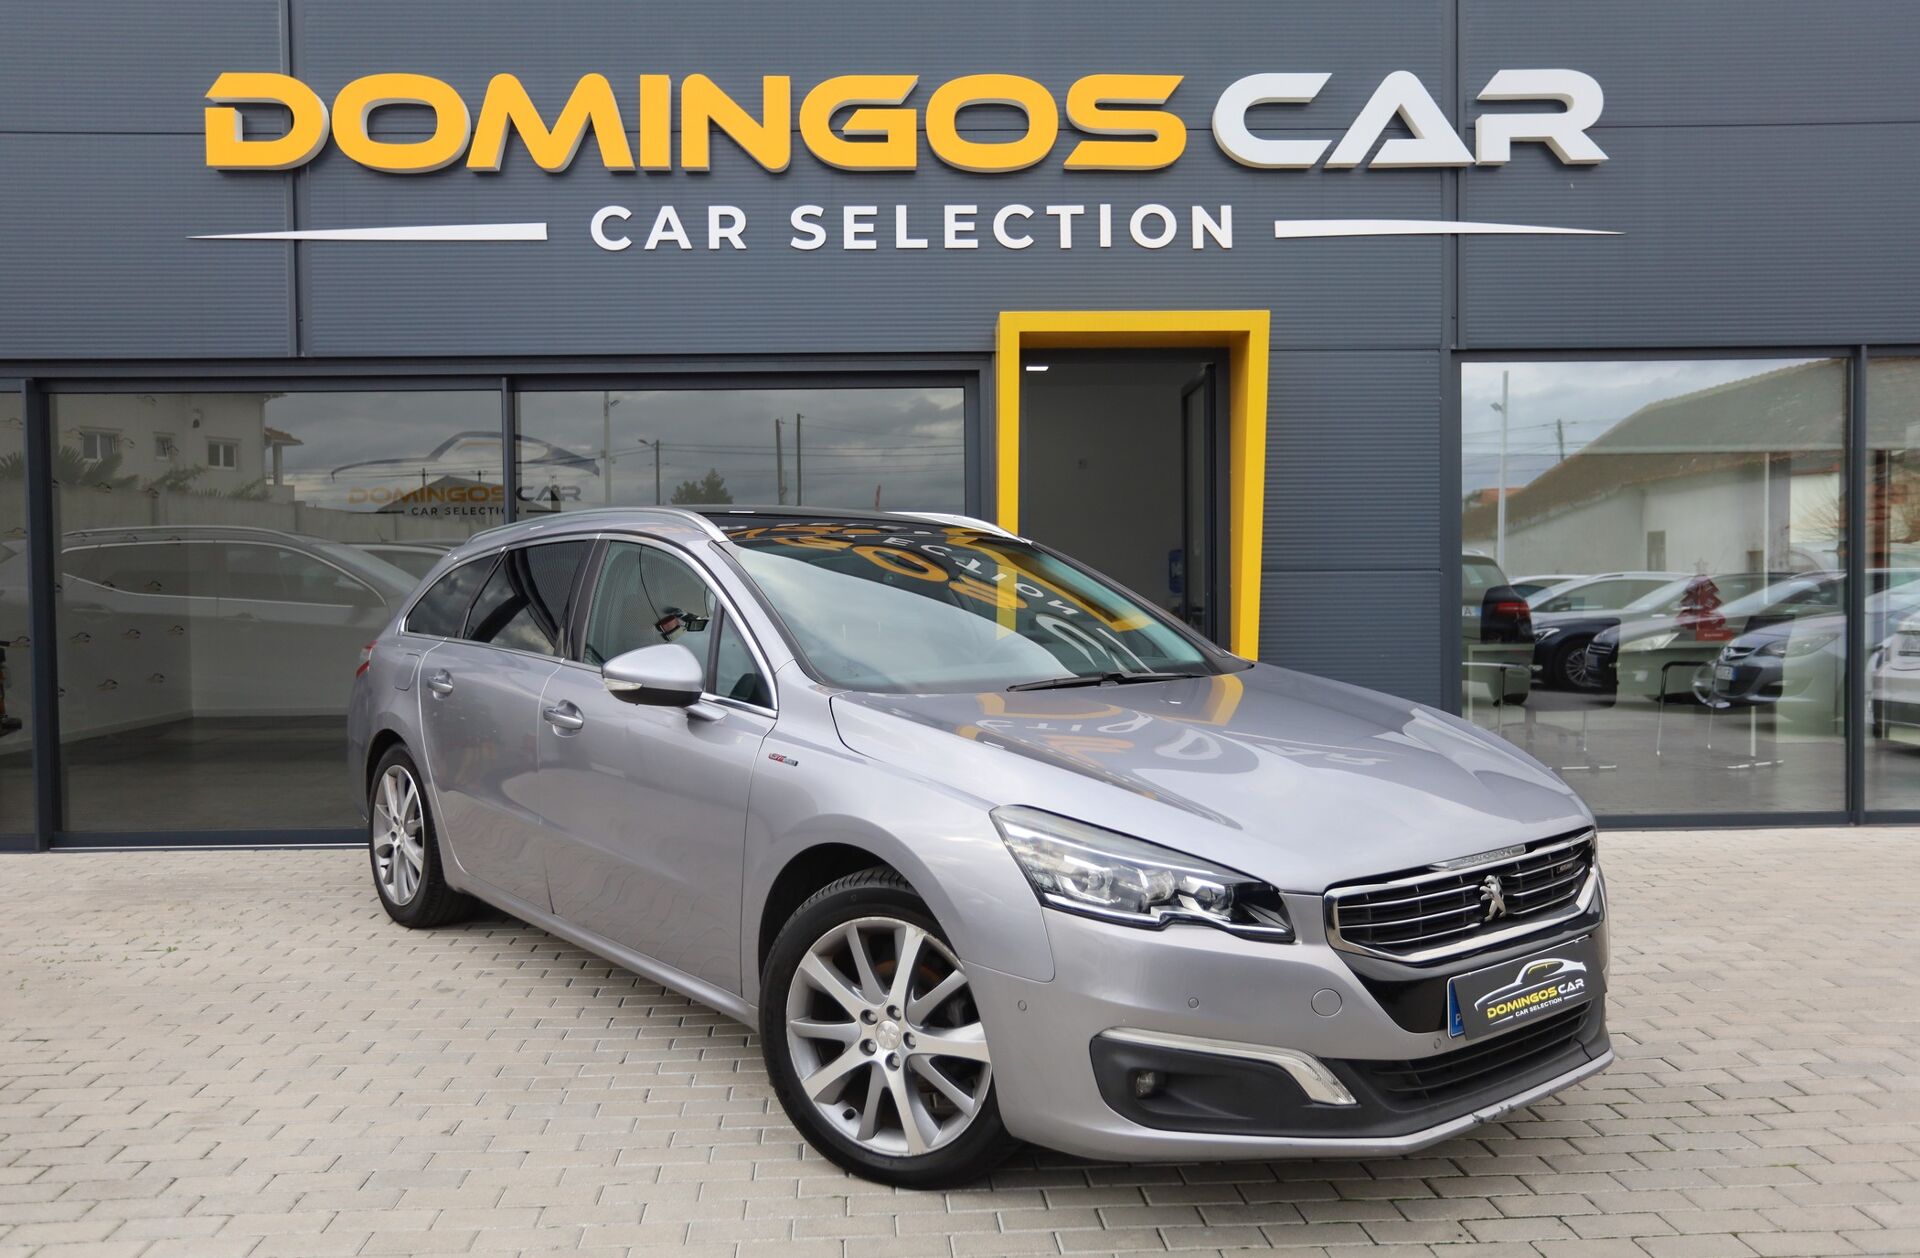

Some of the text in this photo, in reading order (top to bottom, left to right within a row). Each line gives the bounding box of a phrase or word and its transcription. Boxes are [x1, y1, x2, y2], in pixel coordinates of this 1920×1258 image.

[205, 69, 1609, 173] DOMINGOS CAR
[590, 204, 1234, 251] CAR SELECTION
[411, 507, 520, 516] CAR SELECTI
[1487, 978, 1585, 1019] DOMINGOS CAR
[1515, 997, 1563, 1017] CAR SELECTION
